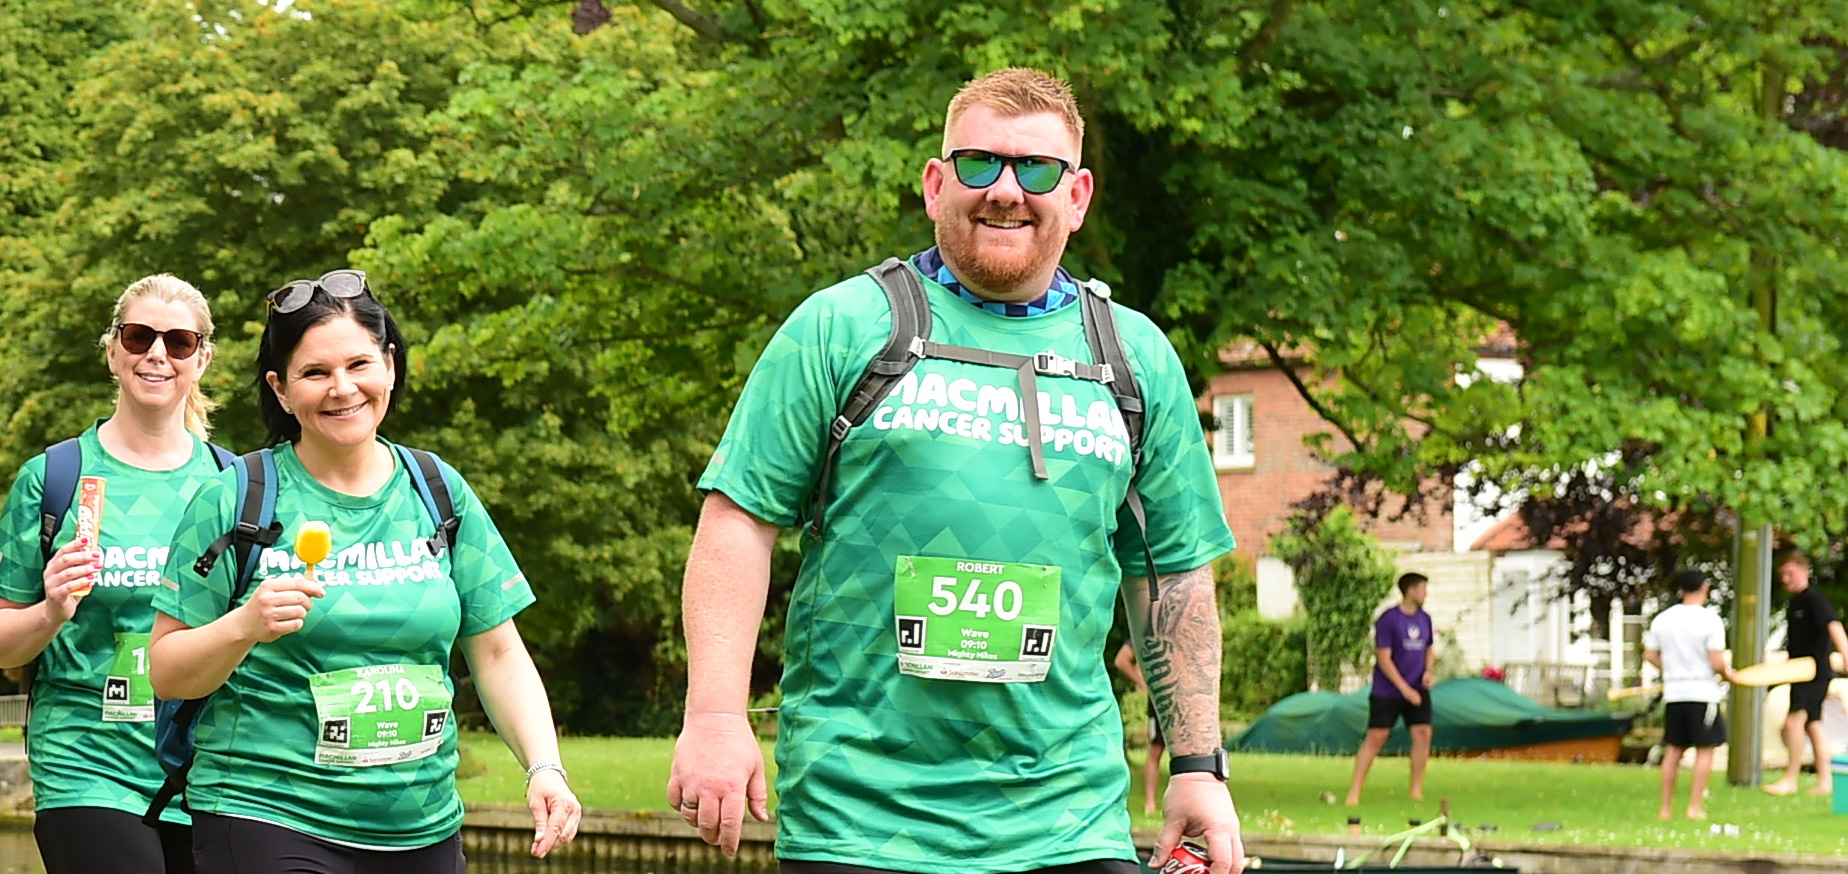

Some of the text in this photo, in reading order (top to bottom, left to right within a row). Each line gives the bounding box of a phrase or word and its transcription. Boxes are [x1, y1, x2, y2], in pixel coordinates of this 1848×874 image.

[883, 371, 1129, 445] MACMLLAN
[873, 406, 992, 441] CANCER
[355, 559, 443, 587] SUPPORT
[956, 562, 1005, 575] ROBERT
[92, 570, 161, 587] ANCER
[928, 576, 1023, 621] 540
[960, 628, 989, 639] Wave
[960, 639, 987, 649] 09:10
[947, 649, 975, 660] Mighty
[355, 665, 406, 678] KAROLINA
[351, 677, 420, 714] 210
[376, 721, 399, 729] Wave
[376, 729, 398, 738] 09:10
